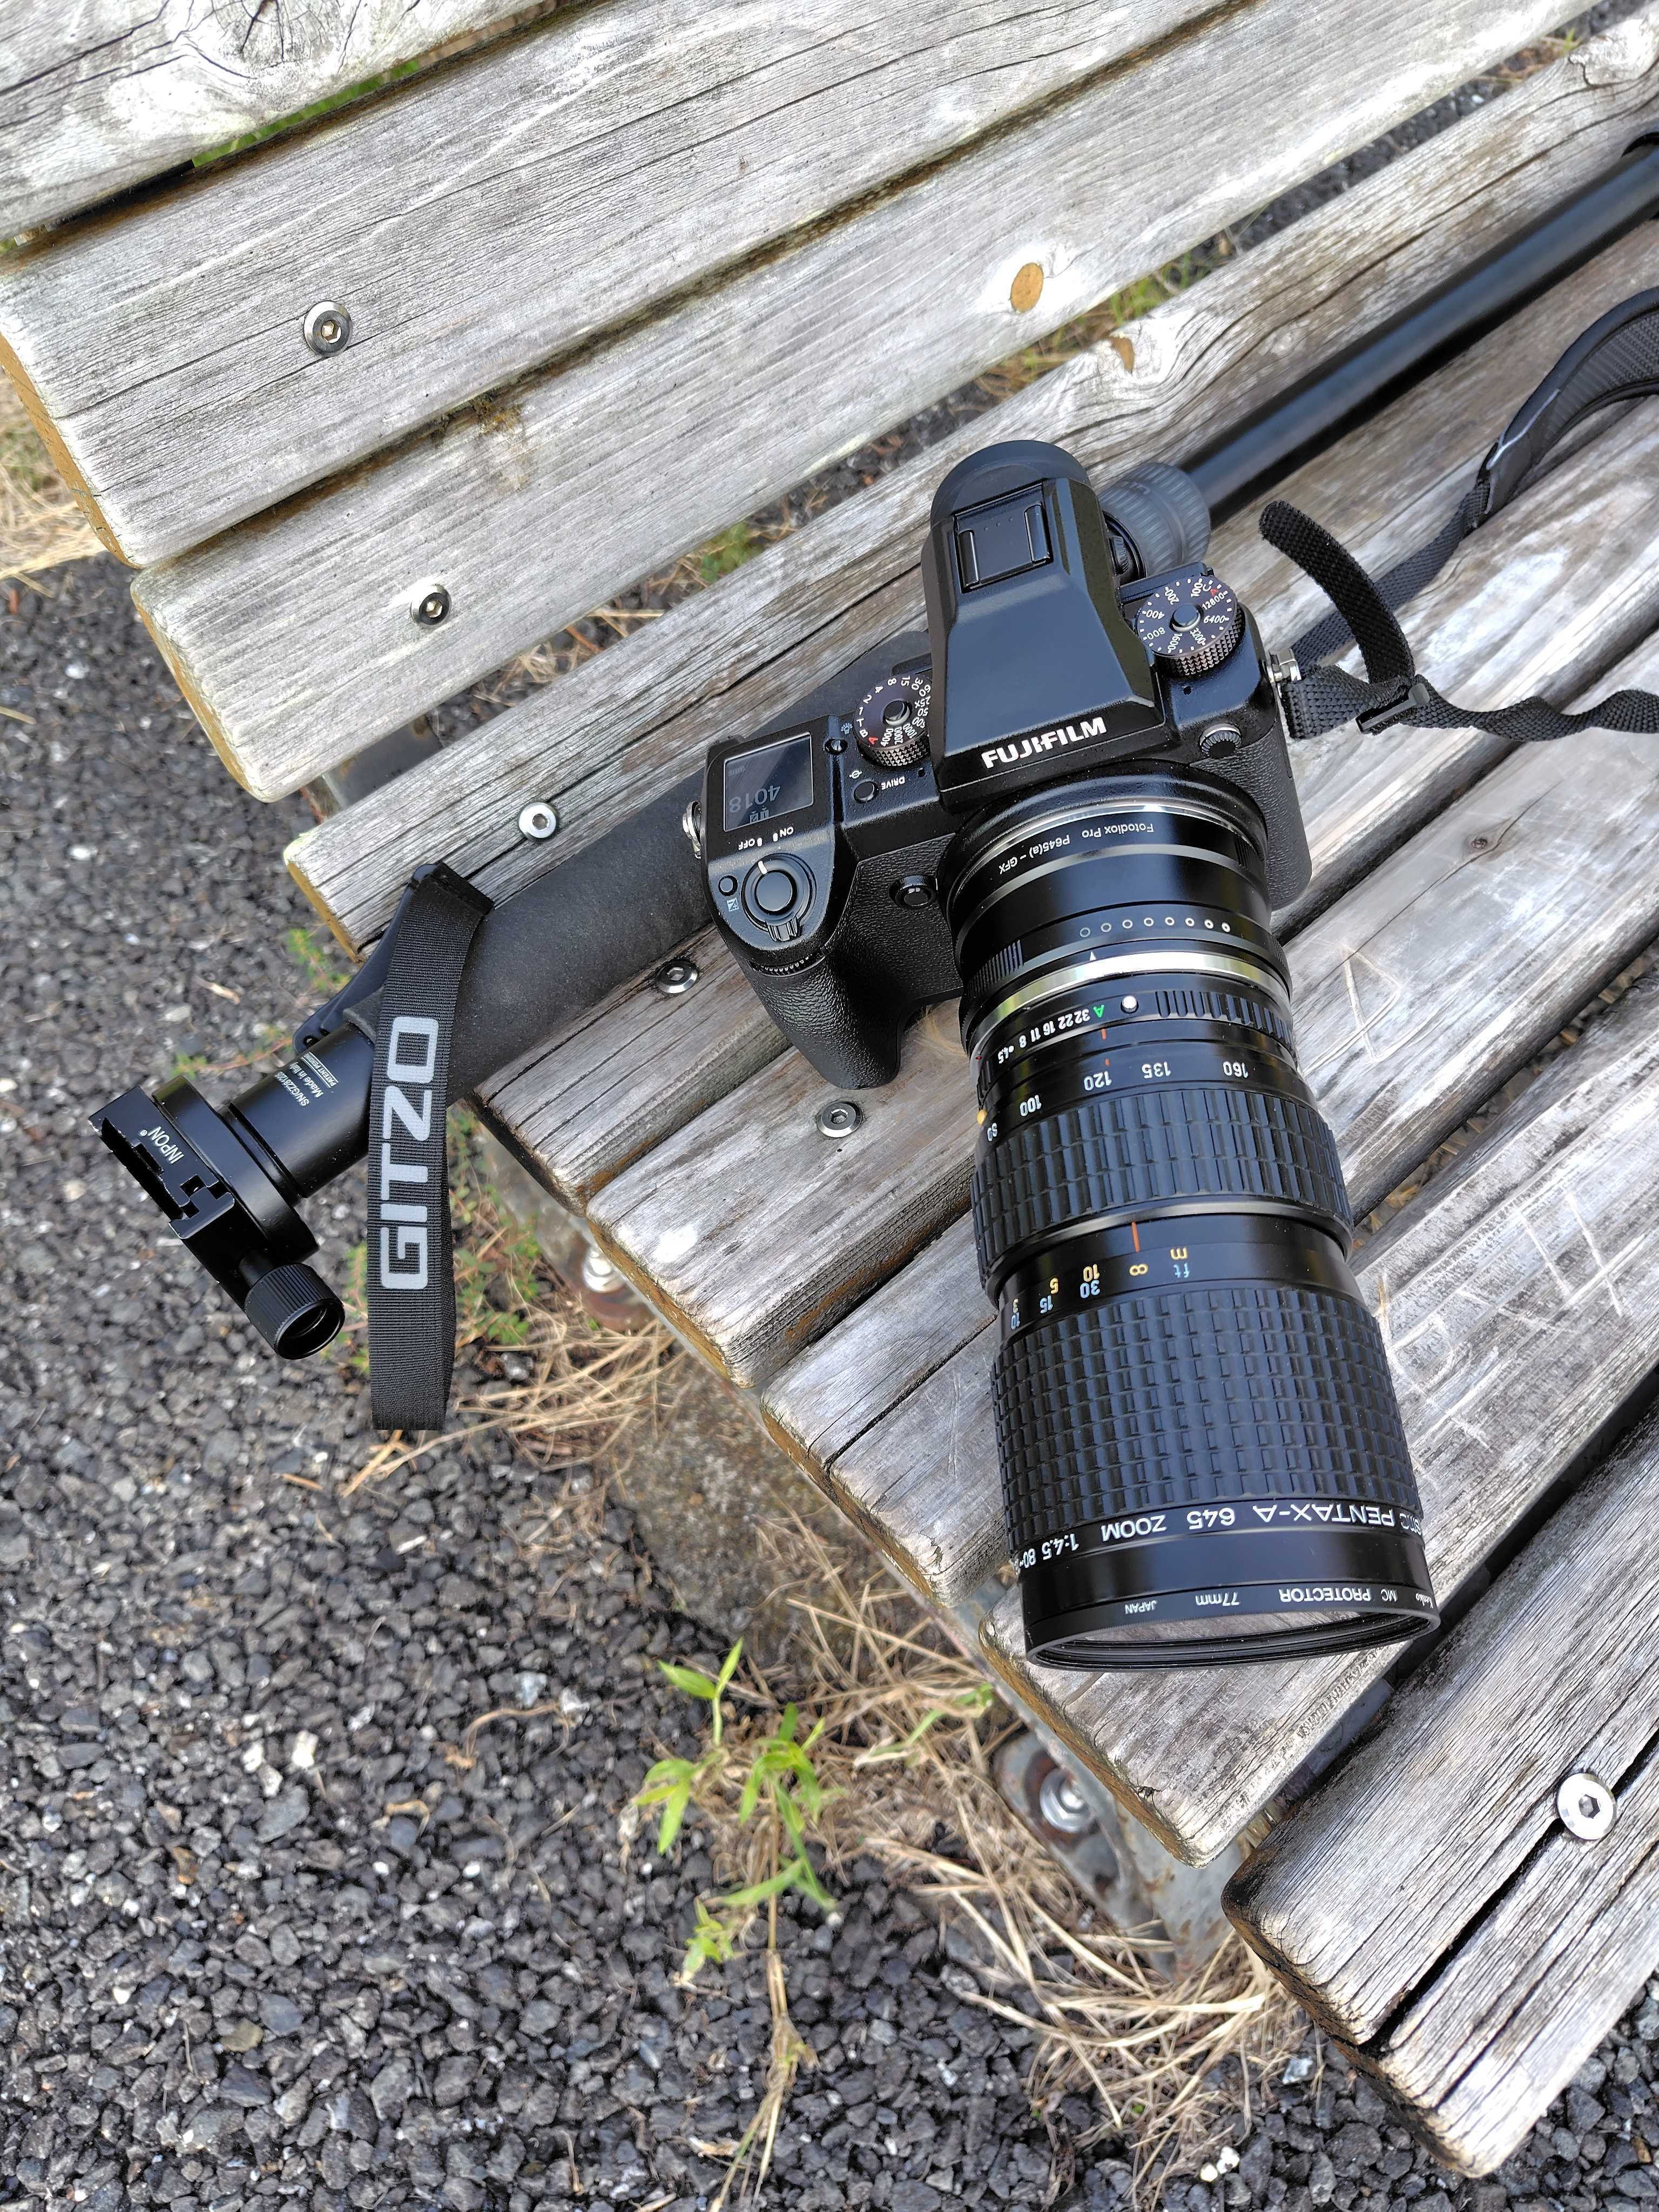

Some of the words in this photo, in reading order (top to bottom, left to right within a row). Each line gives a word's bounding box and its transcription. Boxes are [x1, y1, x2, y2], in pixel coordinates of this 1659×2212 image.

[1164, 589, 1179, 605] 200
[1190, 582, 1203, 597] 100
[1202, 592, 1225, 610] 12800
[1146, 609, 1164, 619] 400
[1203, 615, 1225, 624] 6400
[1147, 627, 1165, 640] 800
[1168, 633, 1183, 650] 1600
[1190, 628, 1206, 645] 3200
[887, 678, 897, 686] 8
[901, 676, 911, 686] 15
[911, 677, 923, 691] 30
[863, 694, 872, 704] 2
[919, 685, 931, 697] 60
[859, 706, 864, 716] 1
[918, 707, 929, 717] 50
[856, 718, 864, 727] T
[859, 729, 868, 738] B
[880, 728, 894, 747] 4000
[894, 726, 903, 745] 2000
[902, 723, 918, 739] 1000
[868, 737, 878, 745] A
[981, 717, 1107, 768] FUJIFILM
[881, 775, 906, 790] DRIVE
[729, 785, 781, 813] 4018
[779, 826, 794, 838] ON
[1081, 828, 1102, 838] Pro
[1104, 823, 1154, 834] Fotodiox
[738, 838, 756, 851] OFF
[1029, 834, 1070, 858] P645(a)
[999, 857, 1018, 874] GFX
[1074, 1009, 1091, 1024] 32
[1093, 1004, 1105, 1018] A
[1043, 1021, 1056, 1036] 16
[1057, 1013, 1074, 1030] 22
[1019, 1035, 1027, 1048] 8
[1030, 1027, 1041, 1042] 11
[289, 1062, 302, 1074] Italy
[299, 1070, 307, 1080] in
[1141, 1061, 1171, 1079] 135
[1222, 1061, 1249, 1080] 160
[318, 1068, 337, 1087] PATENT
[1083, 1071, 1112, 1091] 120
[303, 1076, 324, 1098] Made
[1019, 1095, 1042, 1117] 100
[147, 1126, 184, 1164] INPON
[381, 1016, 439, 1290] GITZO
[1170, 1247, 1188, 1260] m
[1083, 1264, 1100, 1282] 10
[1173, 1262, 1190, 1279] ft
[1049, 1277, 1058, 1294] 5
[1080, 1279, 1101, 1299] 30
[1040, 1295, 1054, 1314] 15
[1010, 1312, 1020, 1330] 10
[1186, 1507, 1236, 1531] 645
[1252, 1503, 1396, 1528] PENTAX-A
[1101, 1514, 1167, 1542] ZOOM
[1041, 1533, 1079, 1560] 1:4.5
[1195, 1591, 1241, 1607] 77mm
[1278, 1587, 1371, 1603] PROTECTOR
[1380, 1588, 1397, 1602] MC
[1124, 1600, 1158, 1615] JAPAN
